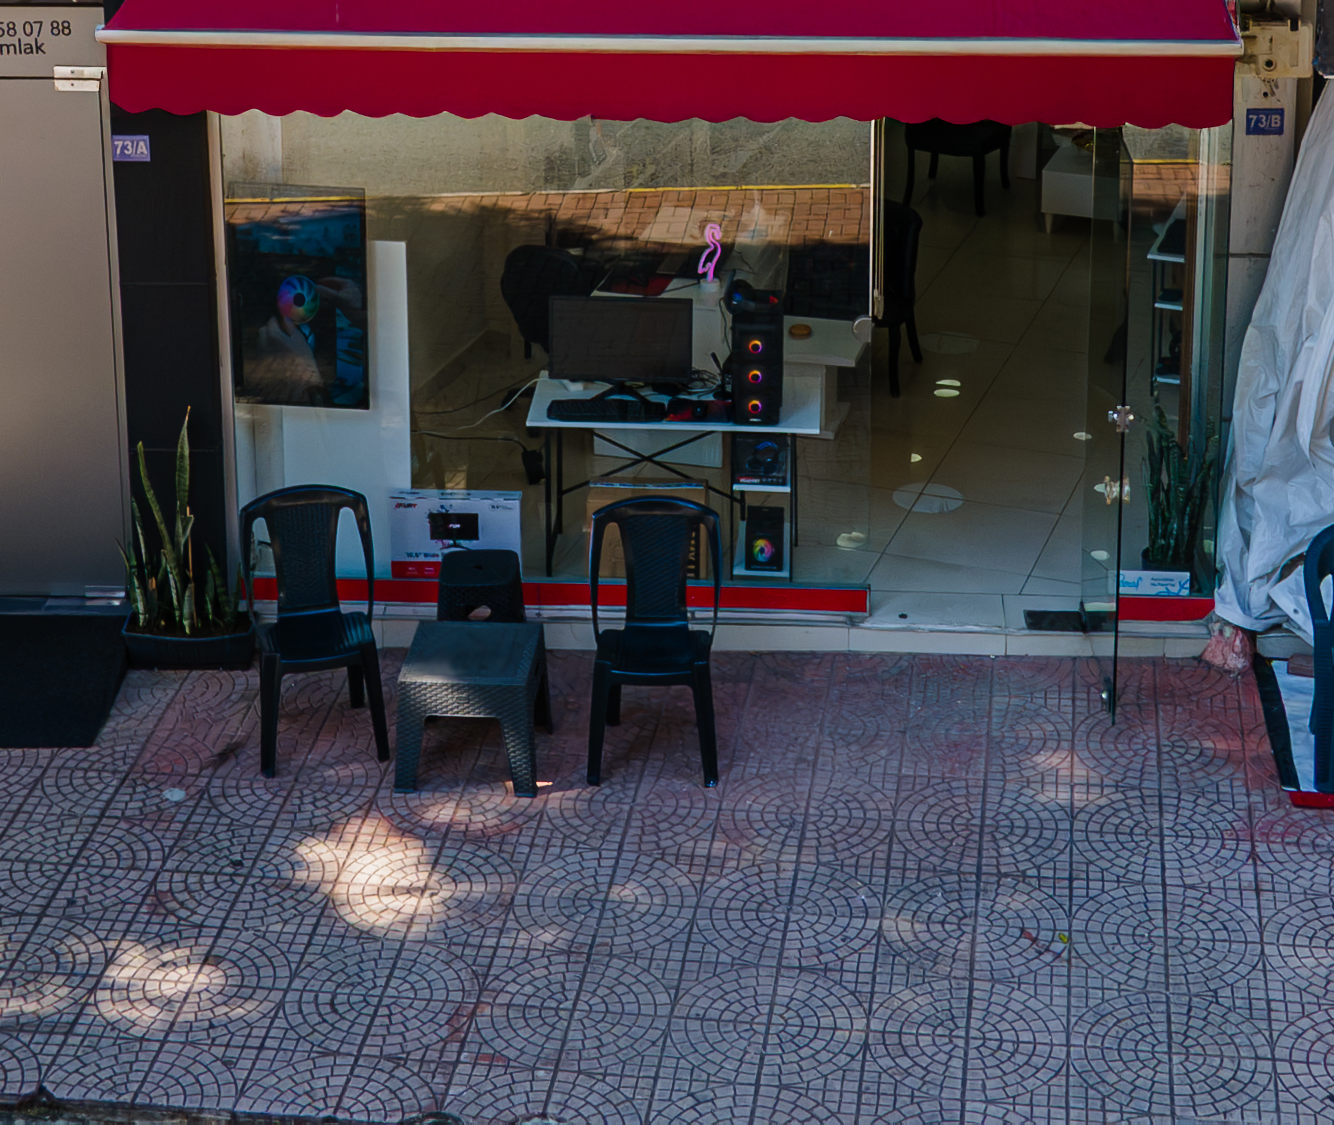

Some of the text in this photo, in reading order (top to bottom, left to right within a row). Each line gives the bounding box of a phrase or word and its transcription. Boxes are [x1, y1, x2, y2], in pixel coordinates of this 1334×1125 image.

[23, 20, 44, 37] 07
[50, 20, 72, 37] 88
[1248, 114, 1281, 130] 73/B
[114, 140, 148, 155] 73/A
